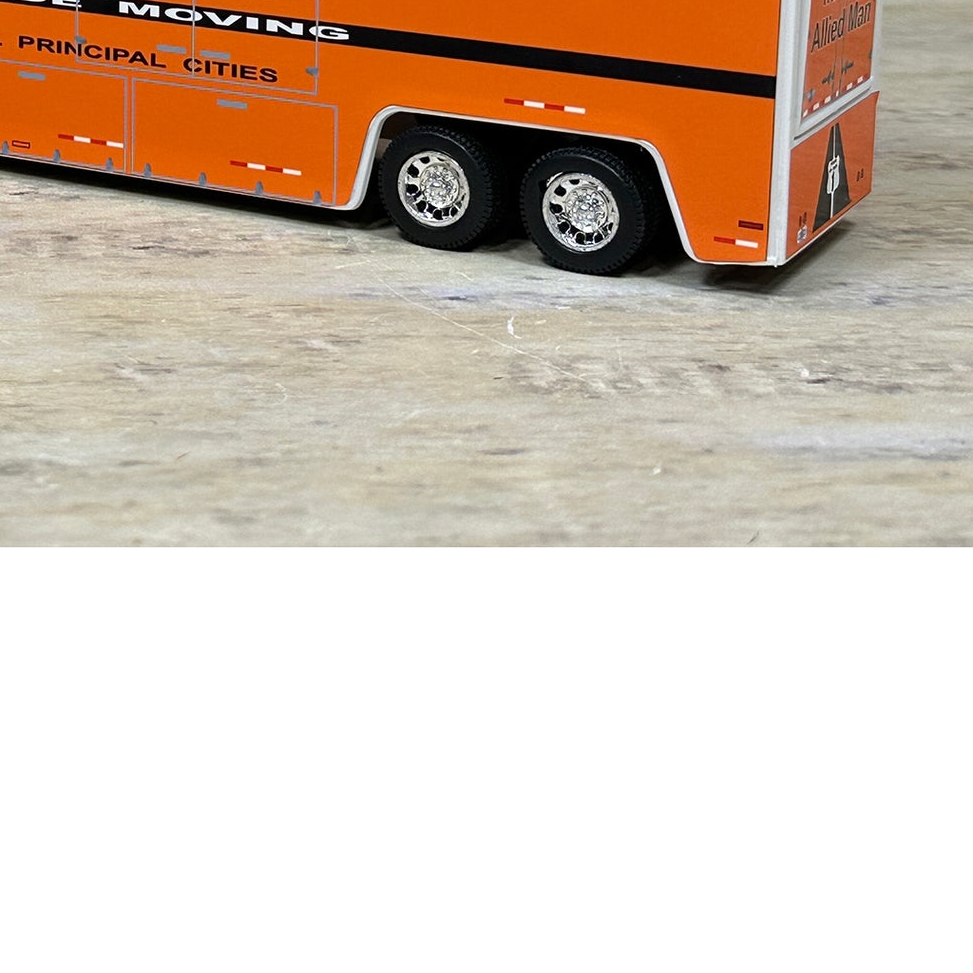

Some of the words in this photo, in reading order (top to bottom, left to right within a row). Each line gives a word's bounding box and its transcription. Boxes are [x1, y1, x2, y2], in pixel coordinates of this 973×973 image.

[118, 0, 350, 41] MOVING
[811, 8, 846, 53] Allied
[847, 0, 872, 32] Man
[18, 35, 167, 69] PRINCIPAL
[182, 57, 279, 84] CITIES
